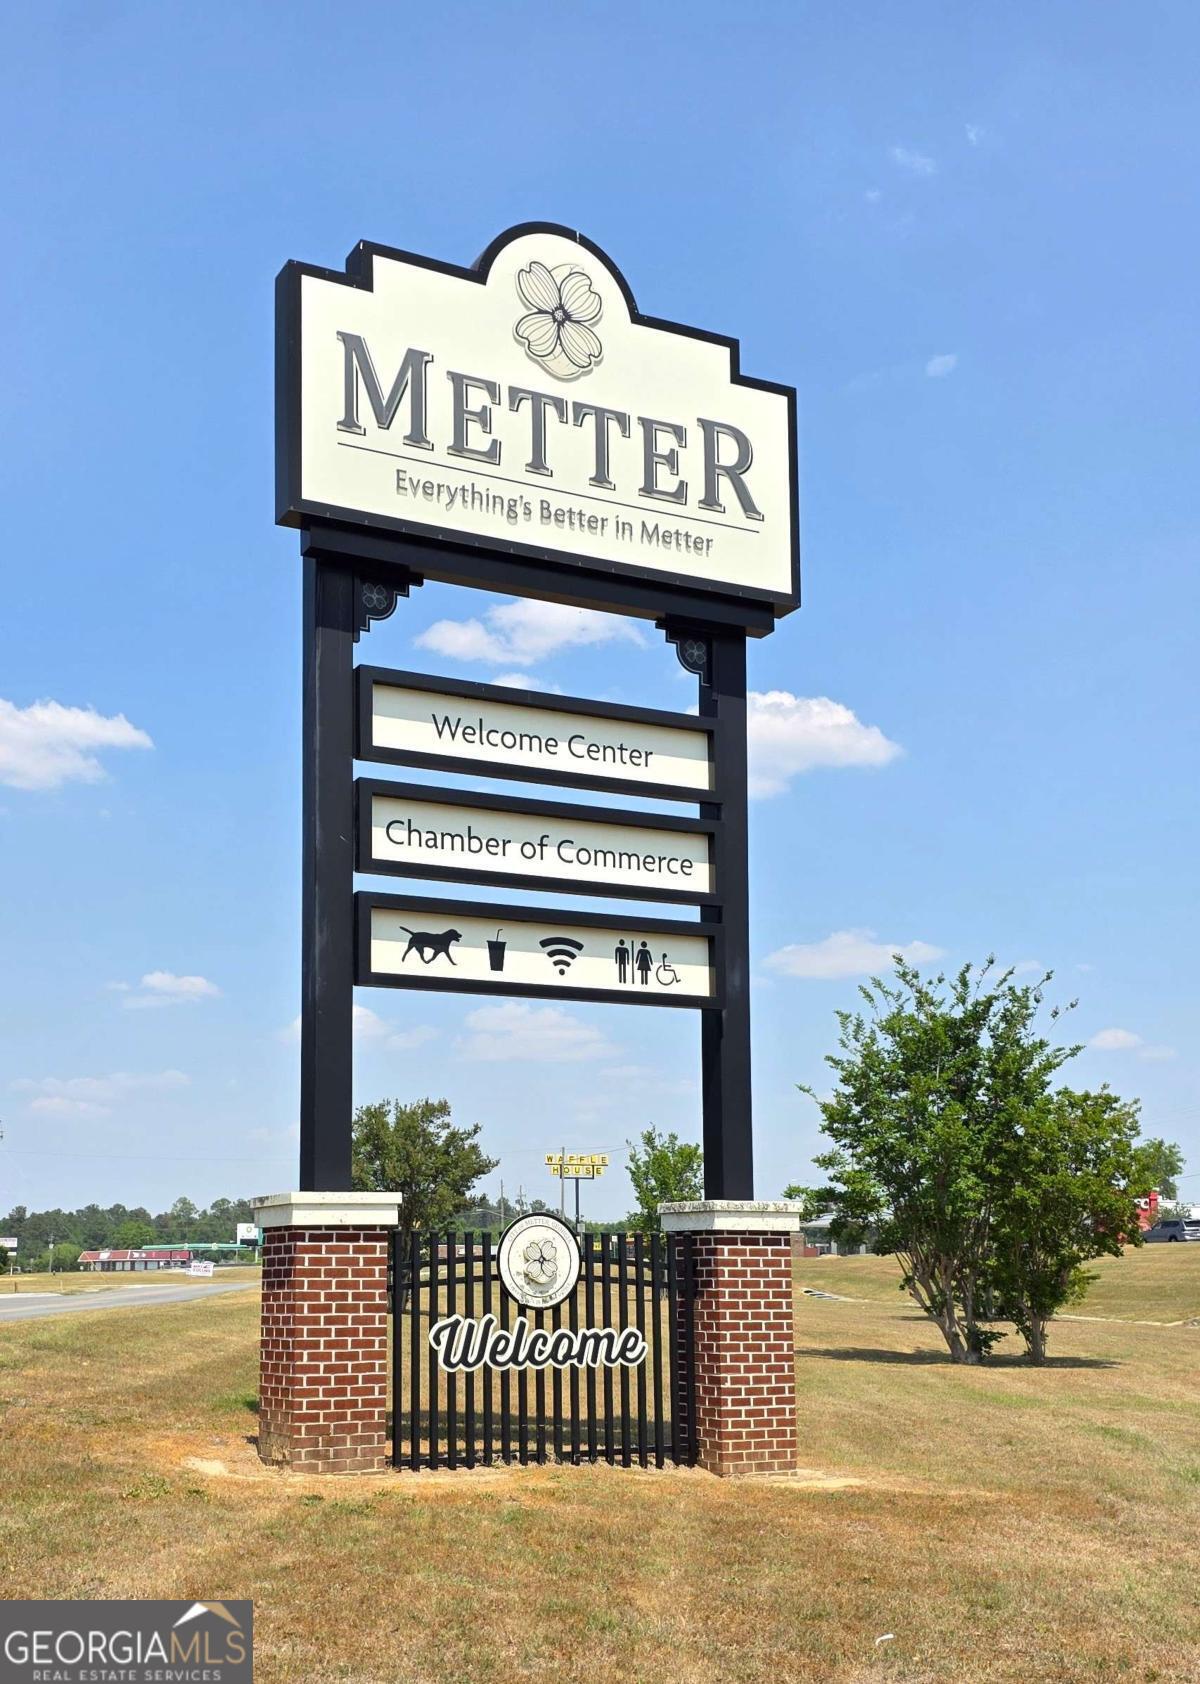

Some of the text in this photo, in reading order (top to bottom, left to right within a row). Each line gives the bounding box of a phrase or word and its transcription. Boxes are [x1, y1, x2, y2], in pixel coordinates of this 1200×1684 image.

[336, 330, 764, 521] METTER
[396, 469, 713, 555] Everything's Better in Metter
[432, 714, 653, 767] Welcome Center
[386, 819, 693, 876] Chamber of Commerce
[546, 1155, 607, 1164] WAFFLE
[552, 1166, 602, 1175] HOUSE
[430, 1314, 646, 1370] Welcome
